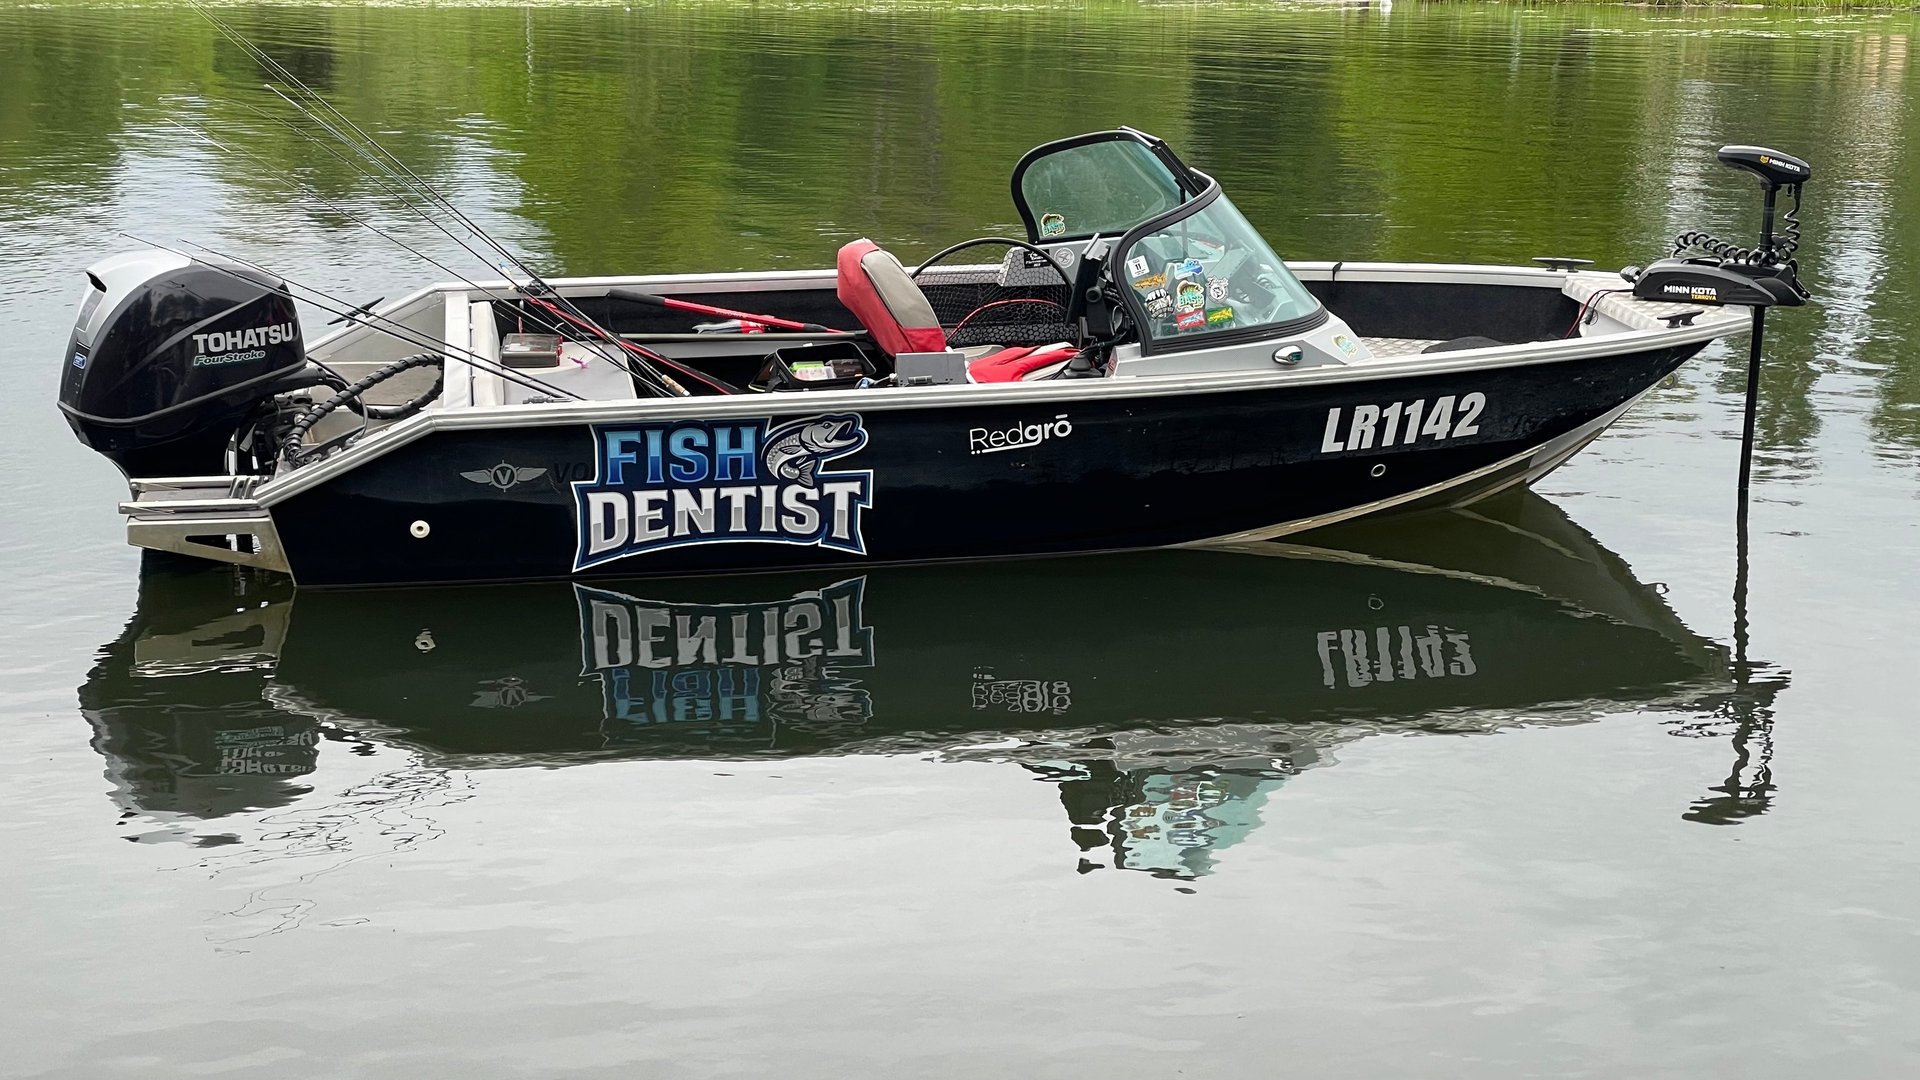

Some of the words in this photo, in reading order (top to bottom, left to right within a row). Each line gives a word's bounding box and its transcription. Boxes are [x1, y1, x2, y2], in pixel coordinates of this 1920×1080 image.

[1663, 285, 1690, 294] MINN
[1690, 286, 1717, 296] KOTA
[192, 322, 293, 354] TOHATSU
[193, 350, 266, 367] FourStroke
[1321, 391, 1486, 453] LR1142
[604, 426, 756, 486] FISH
[587, 481, 861, 556] DENTIST
